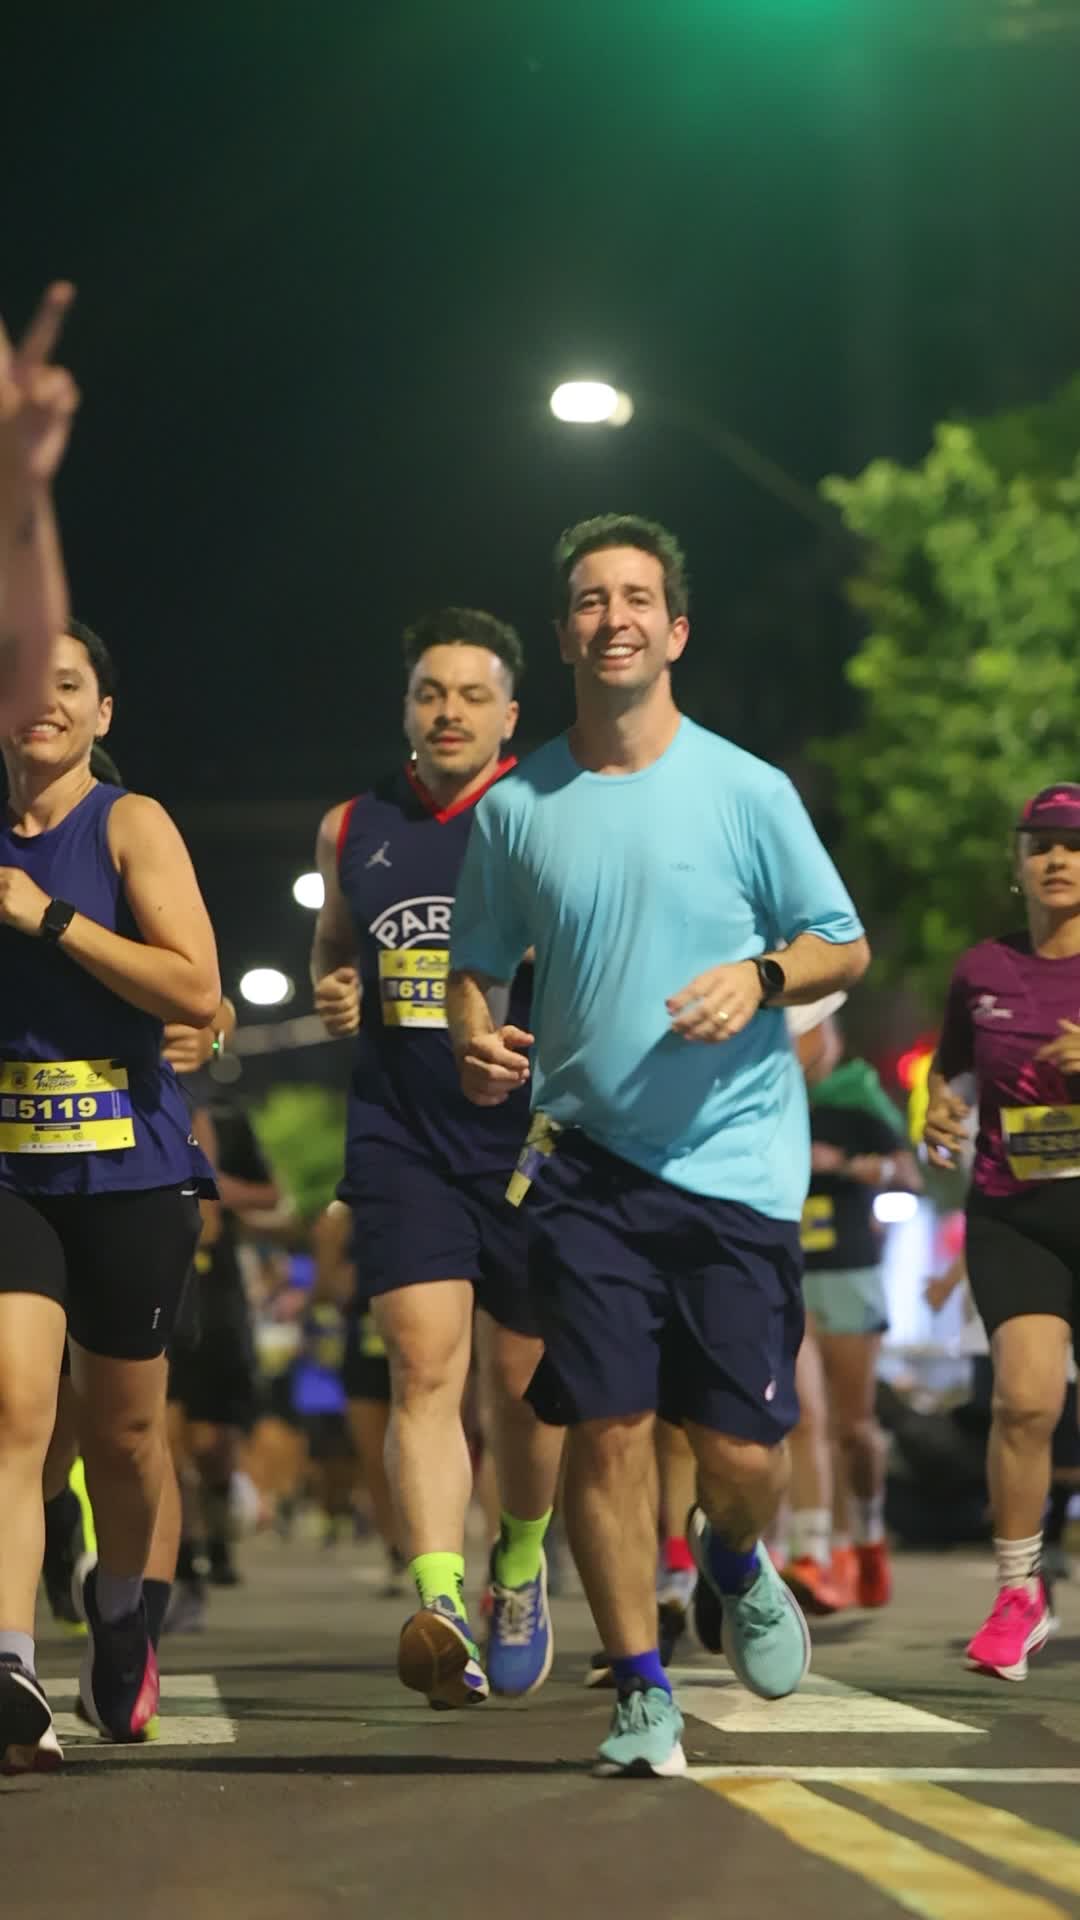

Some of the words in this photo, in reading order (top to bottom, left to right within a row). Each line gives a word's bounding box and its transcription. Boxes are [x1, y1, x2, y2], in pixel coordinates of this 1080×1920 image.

[375, 905, 452, 949] PAR
[399, 982, 446, 1000] 619
[19, 1097, 98, 1120] 5119
